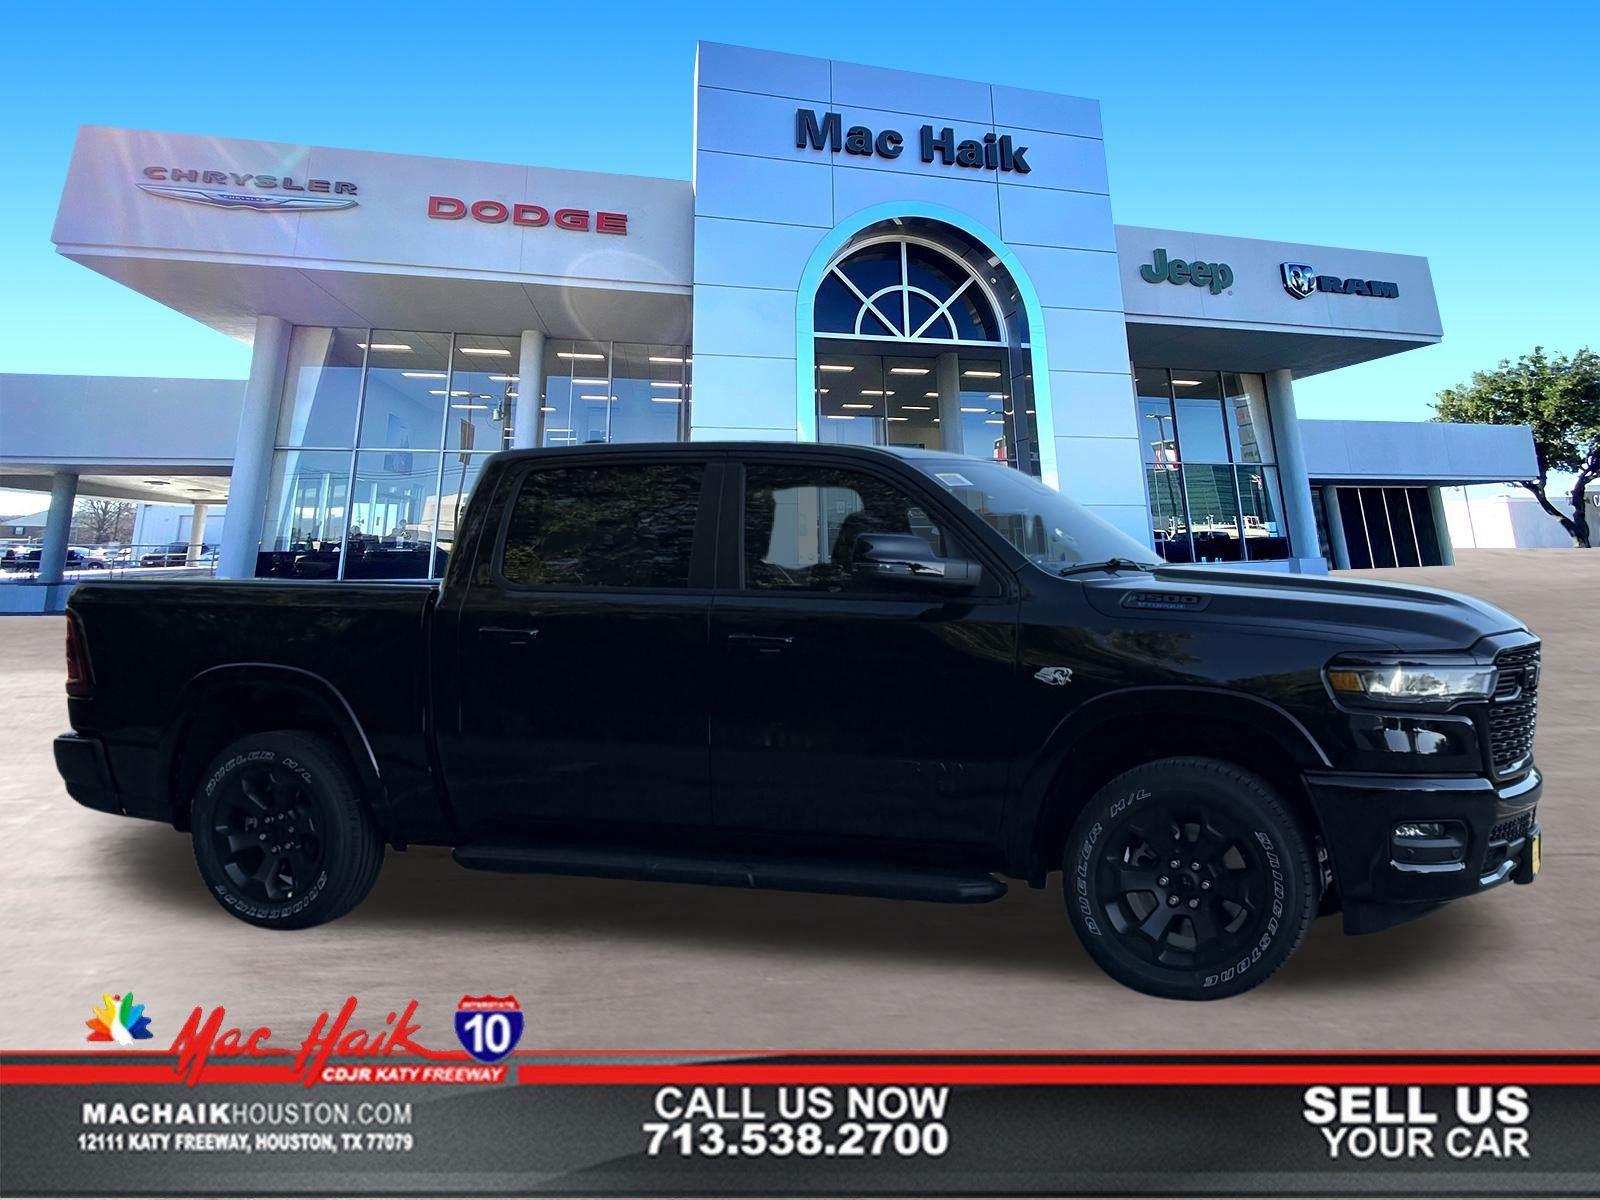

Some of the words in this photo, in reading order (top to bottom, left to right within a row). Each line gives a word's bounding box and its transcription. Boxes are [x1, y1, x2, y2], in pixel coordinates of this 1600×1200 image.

[796, 108, 904, 159] Mac
[920, 124, 1032, 174] Haik
[143, 166, 358, 196] CHRYSLER
[428, 196, 627, 235] DODGE
[1140, 249, 1234, 295] Jeep
[1316, 275, 1399, 299] RAM
[1076, 822, 1103, 936] DUELER
[1109, 789, 1152, 818] H/L
[1203, 831, 1286, 988] BRIDGESTONE
